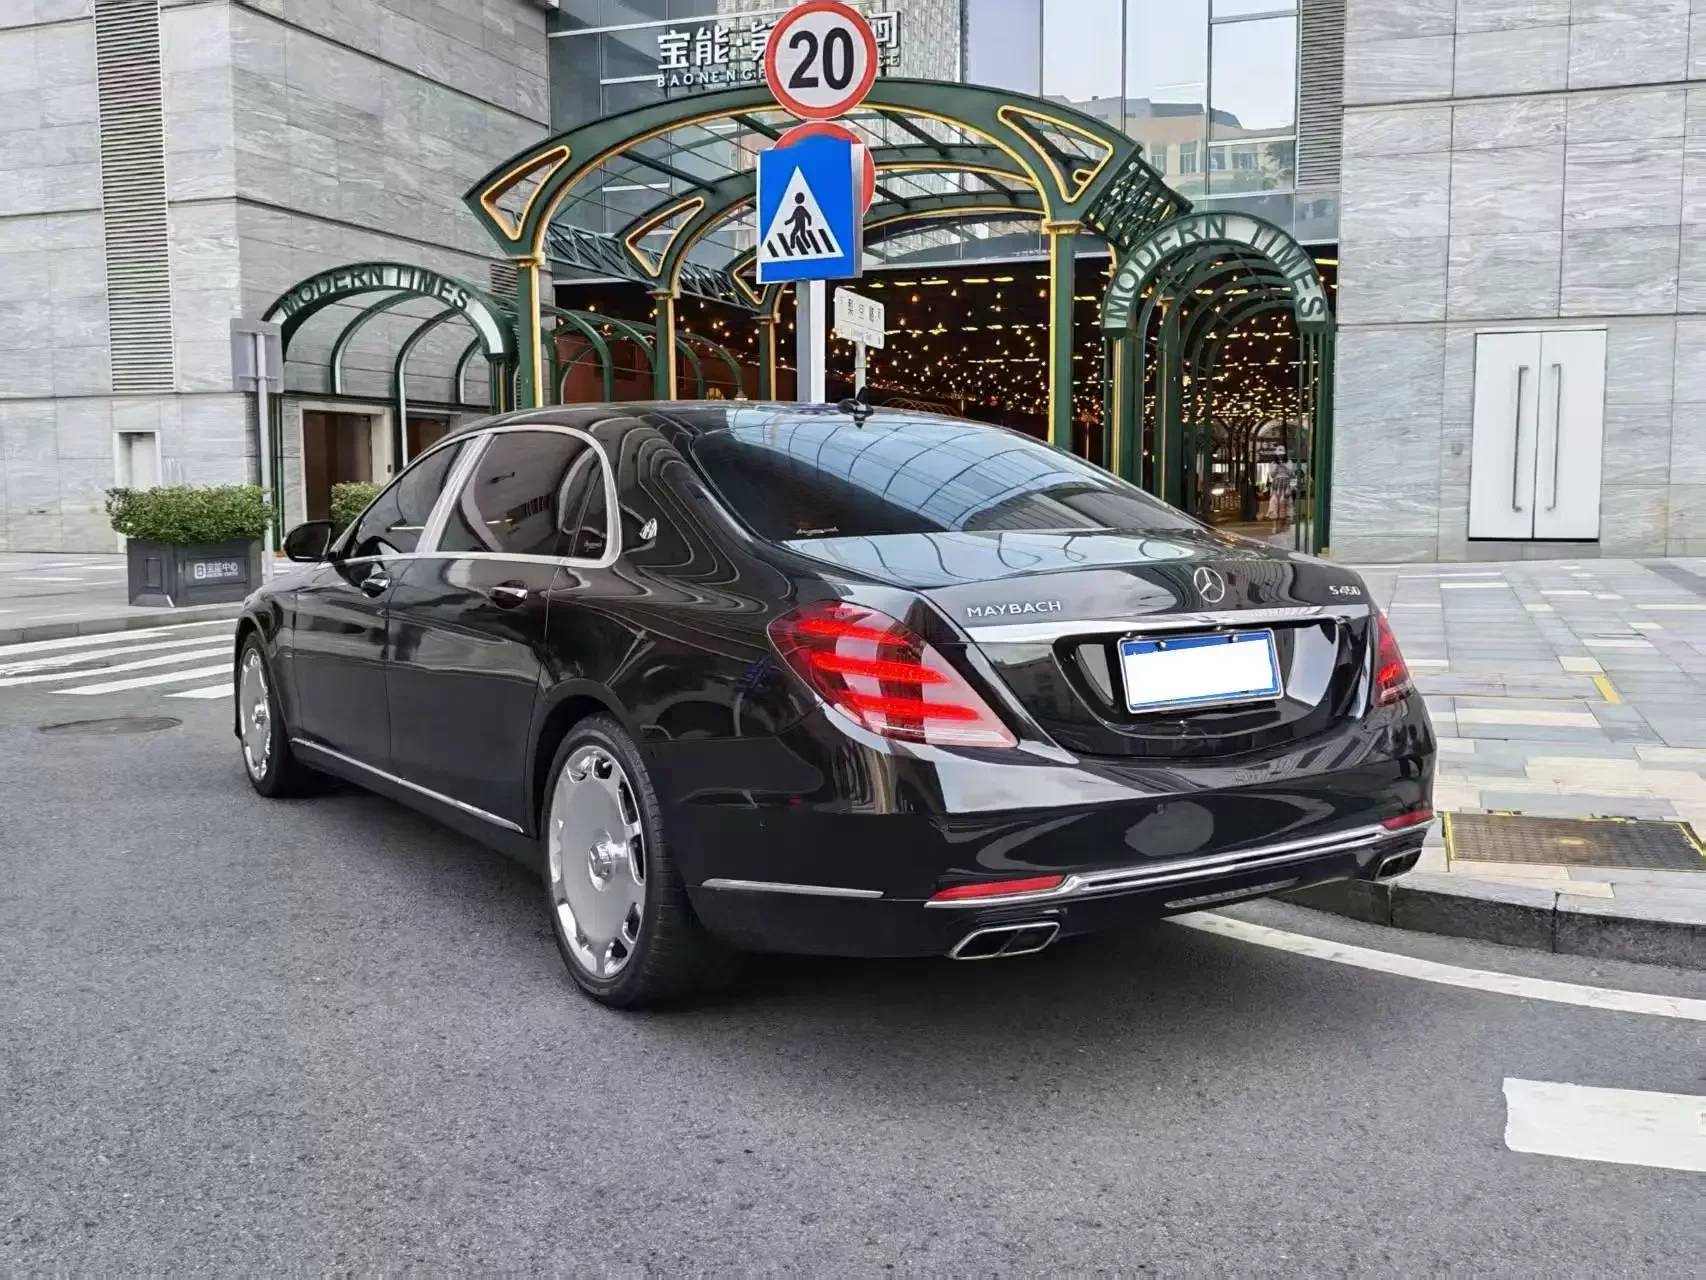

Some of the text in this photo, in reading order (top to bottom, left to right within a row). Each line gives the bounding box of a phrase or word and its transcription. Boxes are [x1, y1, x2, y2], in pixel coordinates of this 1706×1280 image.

[657, 68, 757, 88] BAONENG
[788, 27, 855, 90] 20
[280, 266, 471, 318] MODERN TIMES
[1105, 215, 1324, 321] MODERN TIMES
[966, 600, 1062, 617] MAYBACH
